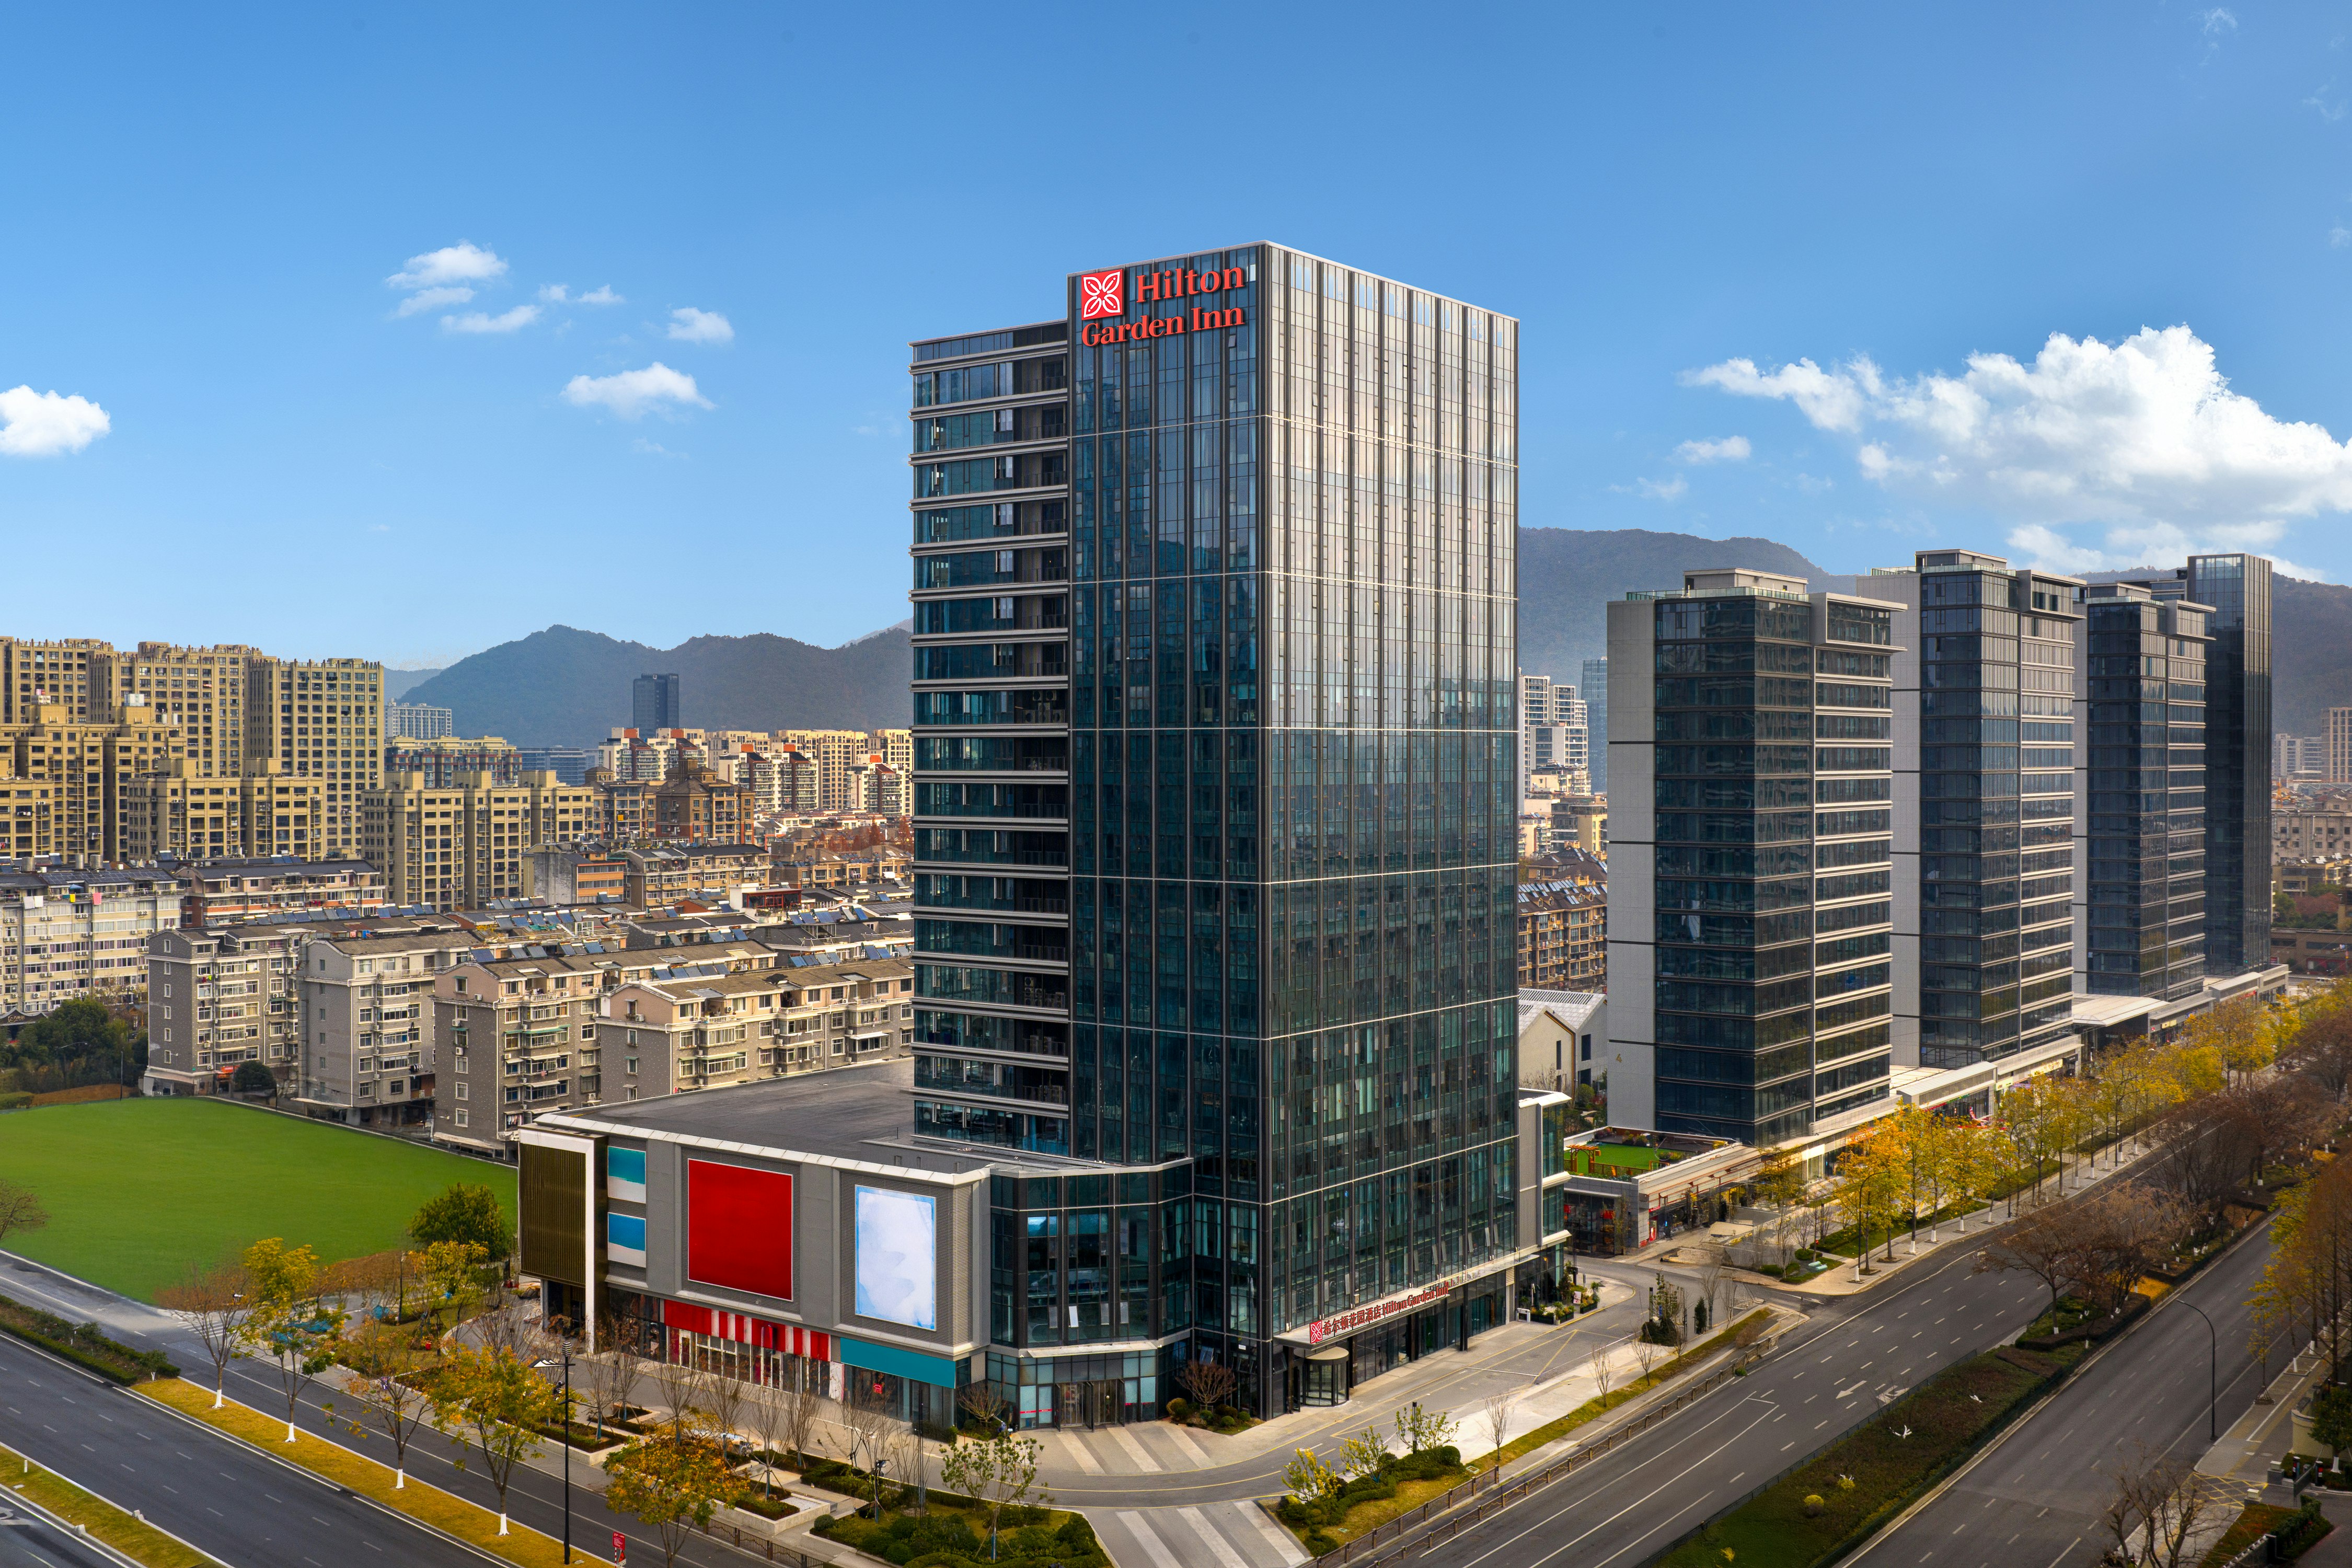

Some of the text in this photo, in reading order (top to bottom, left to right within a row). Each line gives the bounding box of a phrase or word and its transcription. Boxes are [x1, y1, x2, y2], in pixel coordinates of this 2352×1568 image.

[1136, 267, 1244, 303] Hilton
[1081, 307, 1245, 346] Garden Inn
[1323, 1286, 1448, 1335] 希尔顿花园酒店 Hilton Garden Inn
